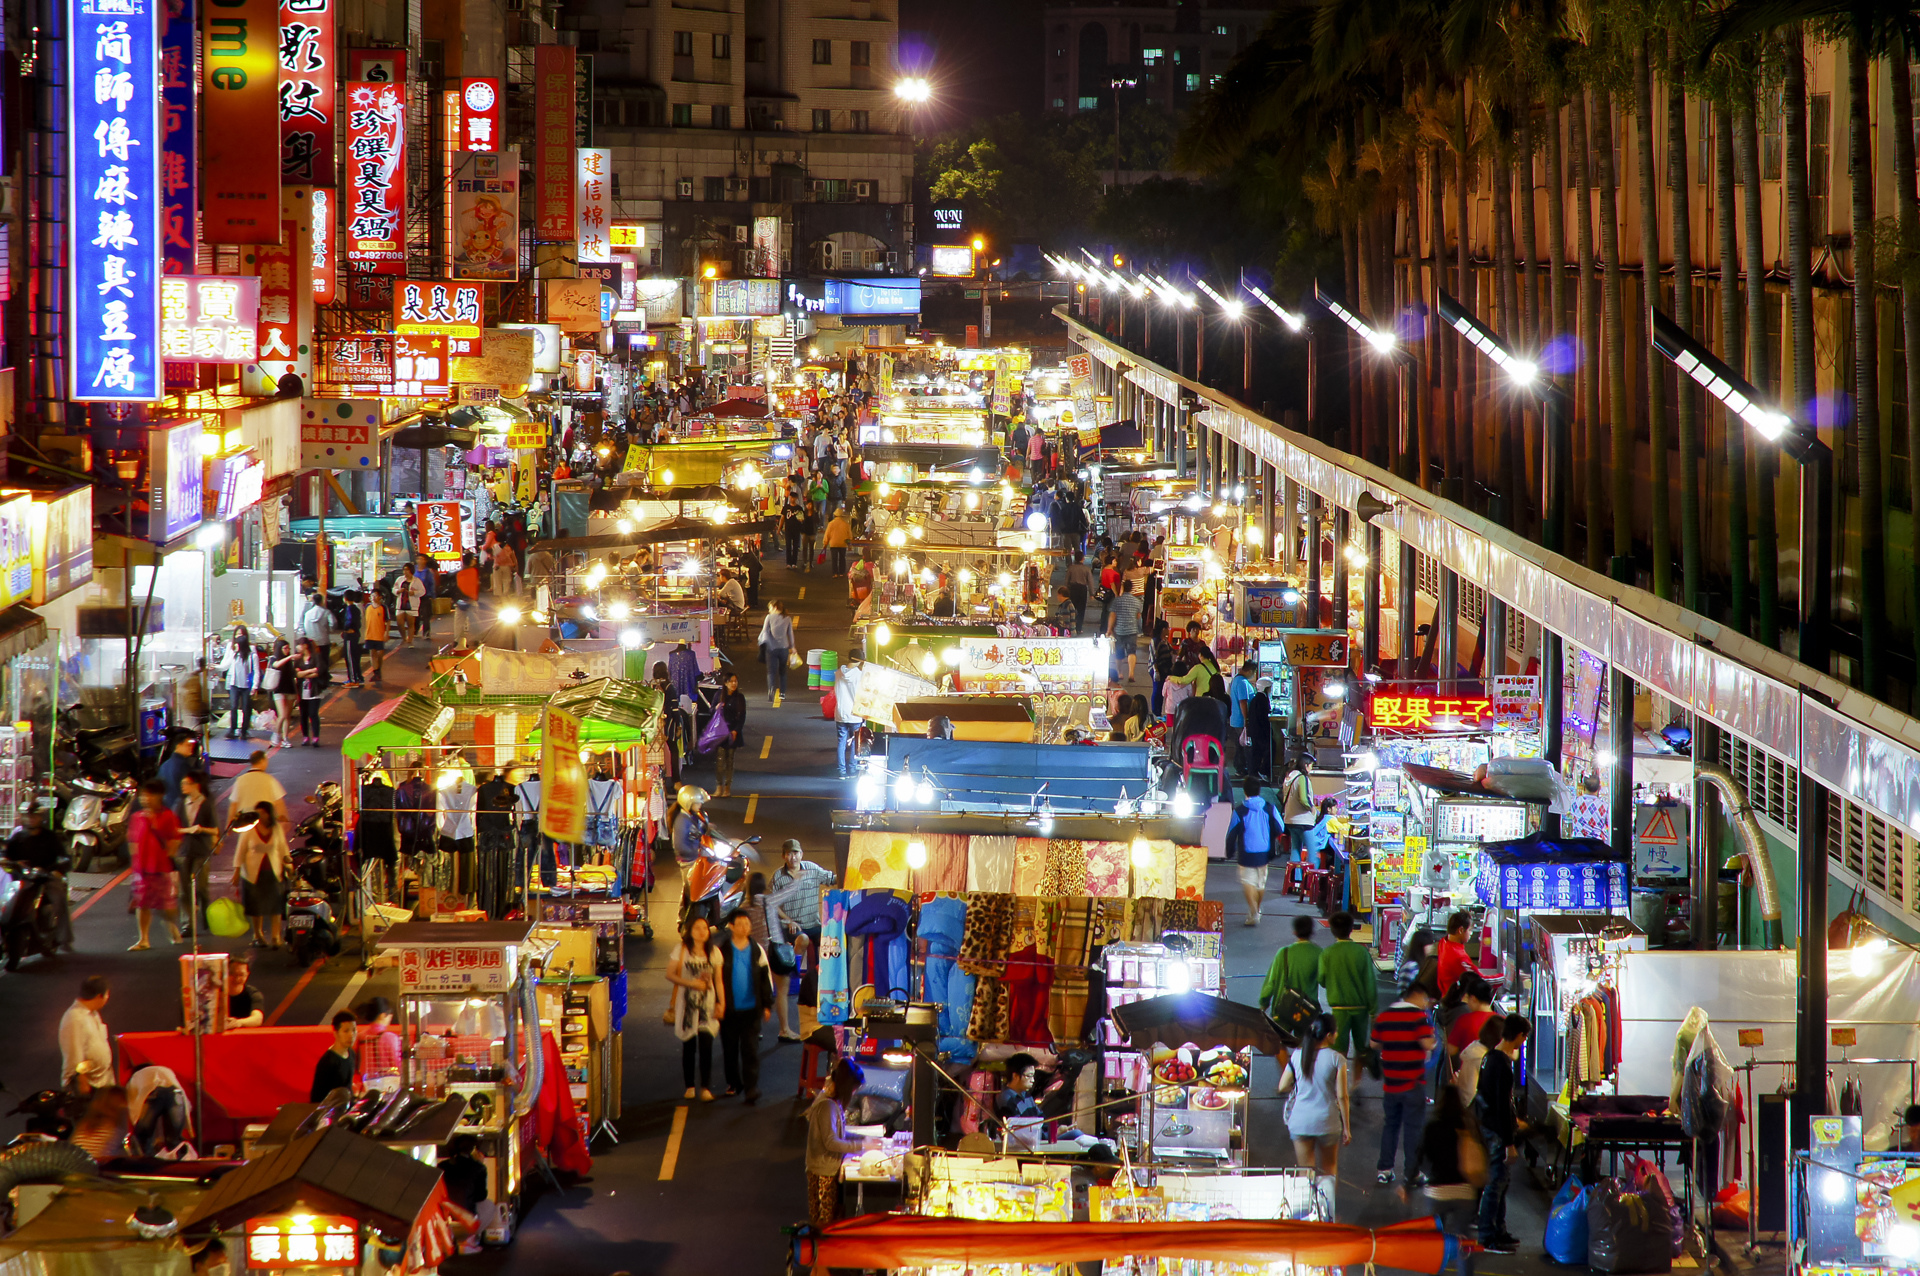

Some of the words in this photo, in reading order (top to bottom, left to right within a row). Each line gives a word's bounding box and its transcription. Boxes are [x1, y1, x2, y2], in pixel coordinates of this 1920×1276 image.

[582, 152, 605, 258] 建信棉被
[348, 251, 404, 260] 03-4927806
[401, 284, 480, 324] 臭臭鍋
[877, 296, 890, 304] tea
[890, 296, 903, 304] tea
[426, 505, 454, 552] 臭臭鍋
[1261, 610, 1295, 624] 仙草凍
[1372, 697, 1493, 728] 堅果王子
[1647, 846, 1669, 866] 慢
[402, 949, 419, 984] 黃金
[425, 948, 503, 971] 炸彈燒
